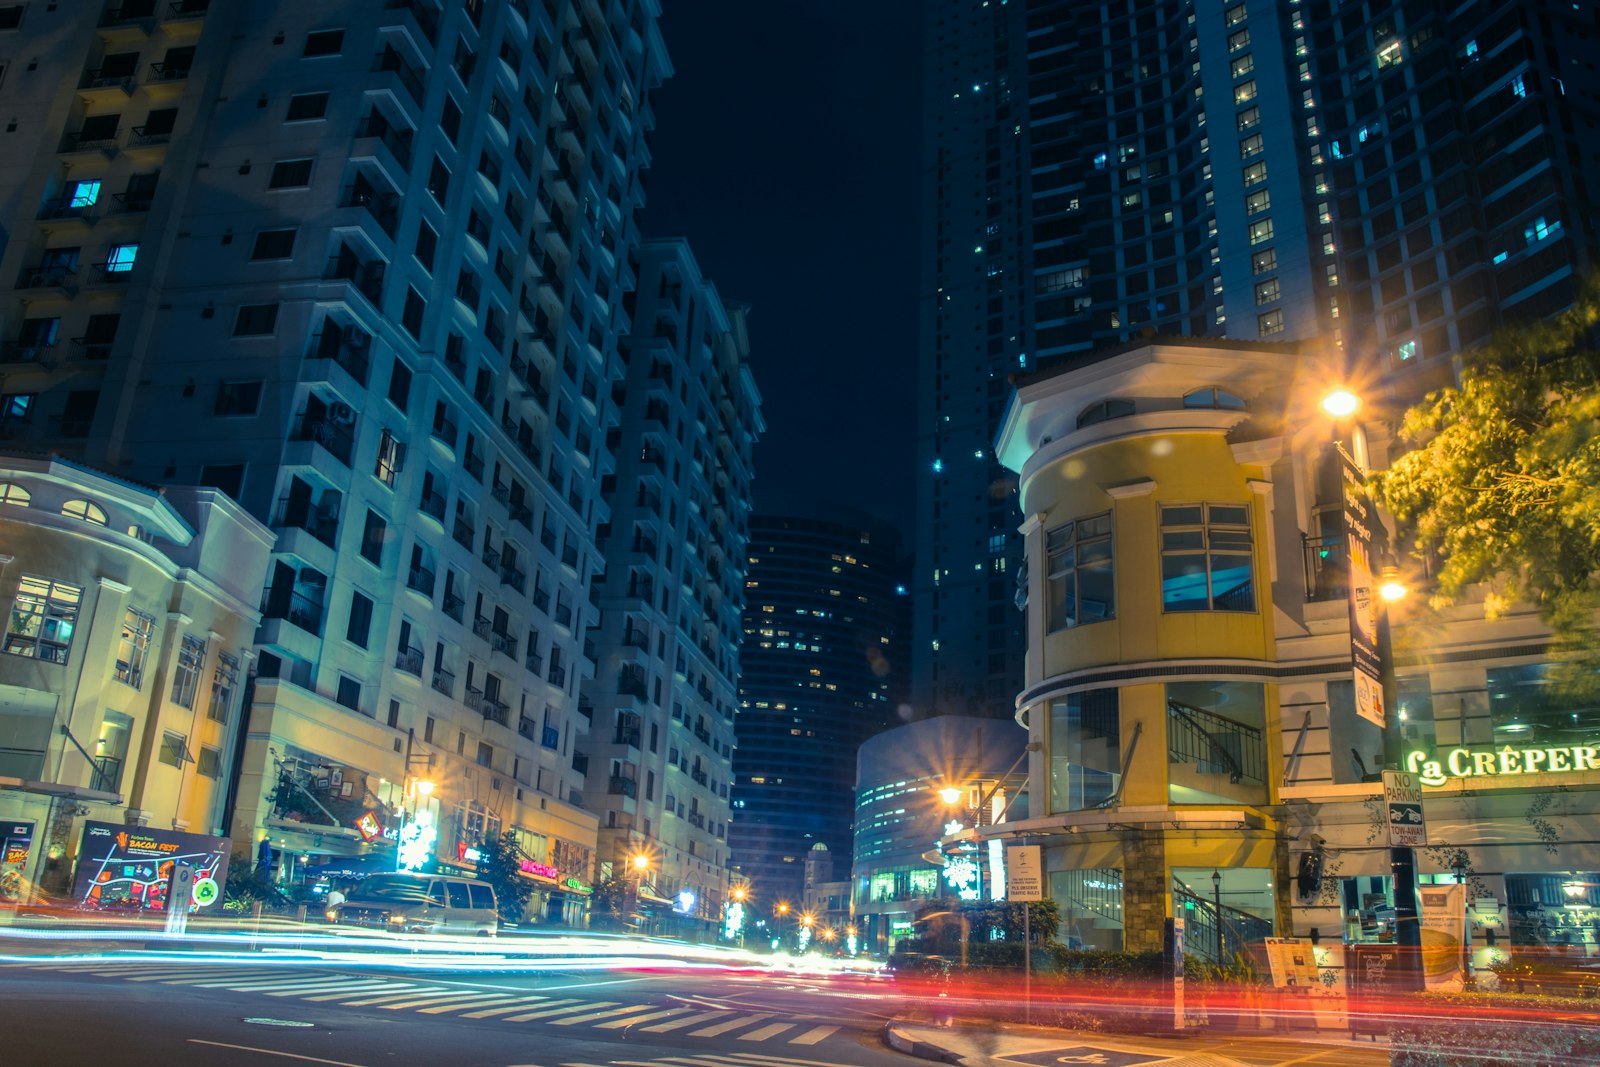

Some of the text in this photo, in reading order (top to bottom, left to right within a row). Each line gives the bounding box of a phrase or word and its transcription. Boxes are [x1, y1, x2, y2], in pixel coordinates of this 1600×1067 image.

[1394, 774, 1411, 788] NO
[1387, 787, 1420, 802] PARKING
[1391, 826, 1424, 835] TOW-AWAY
[129, 840, 180, 852] BACON FEST
[1400, 836, 1418, 845] ZONE
